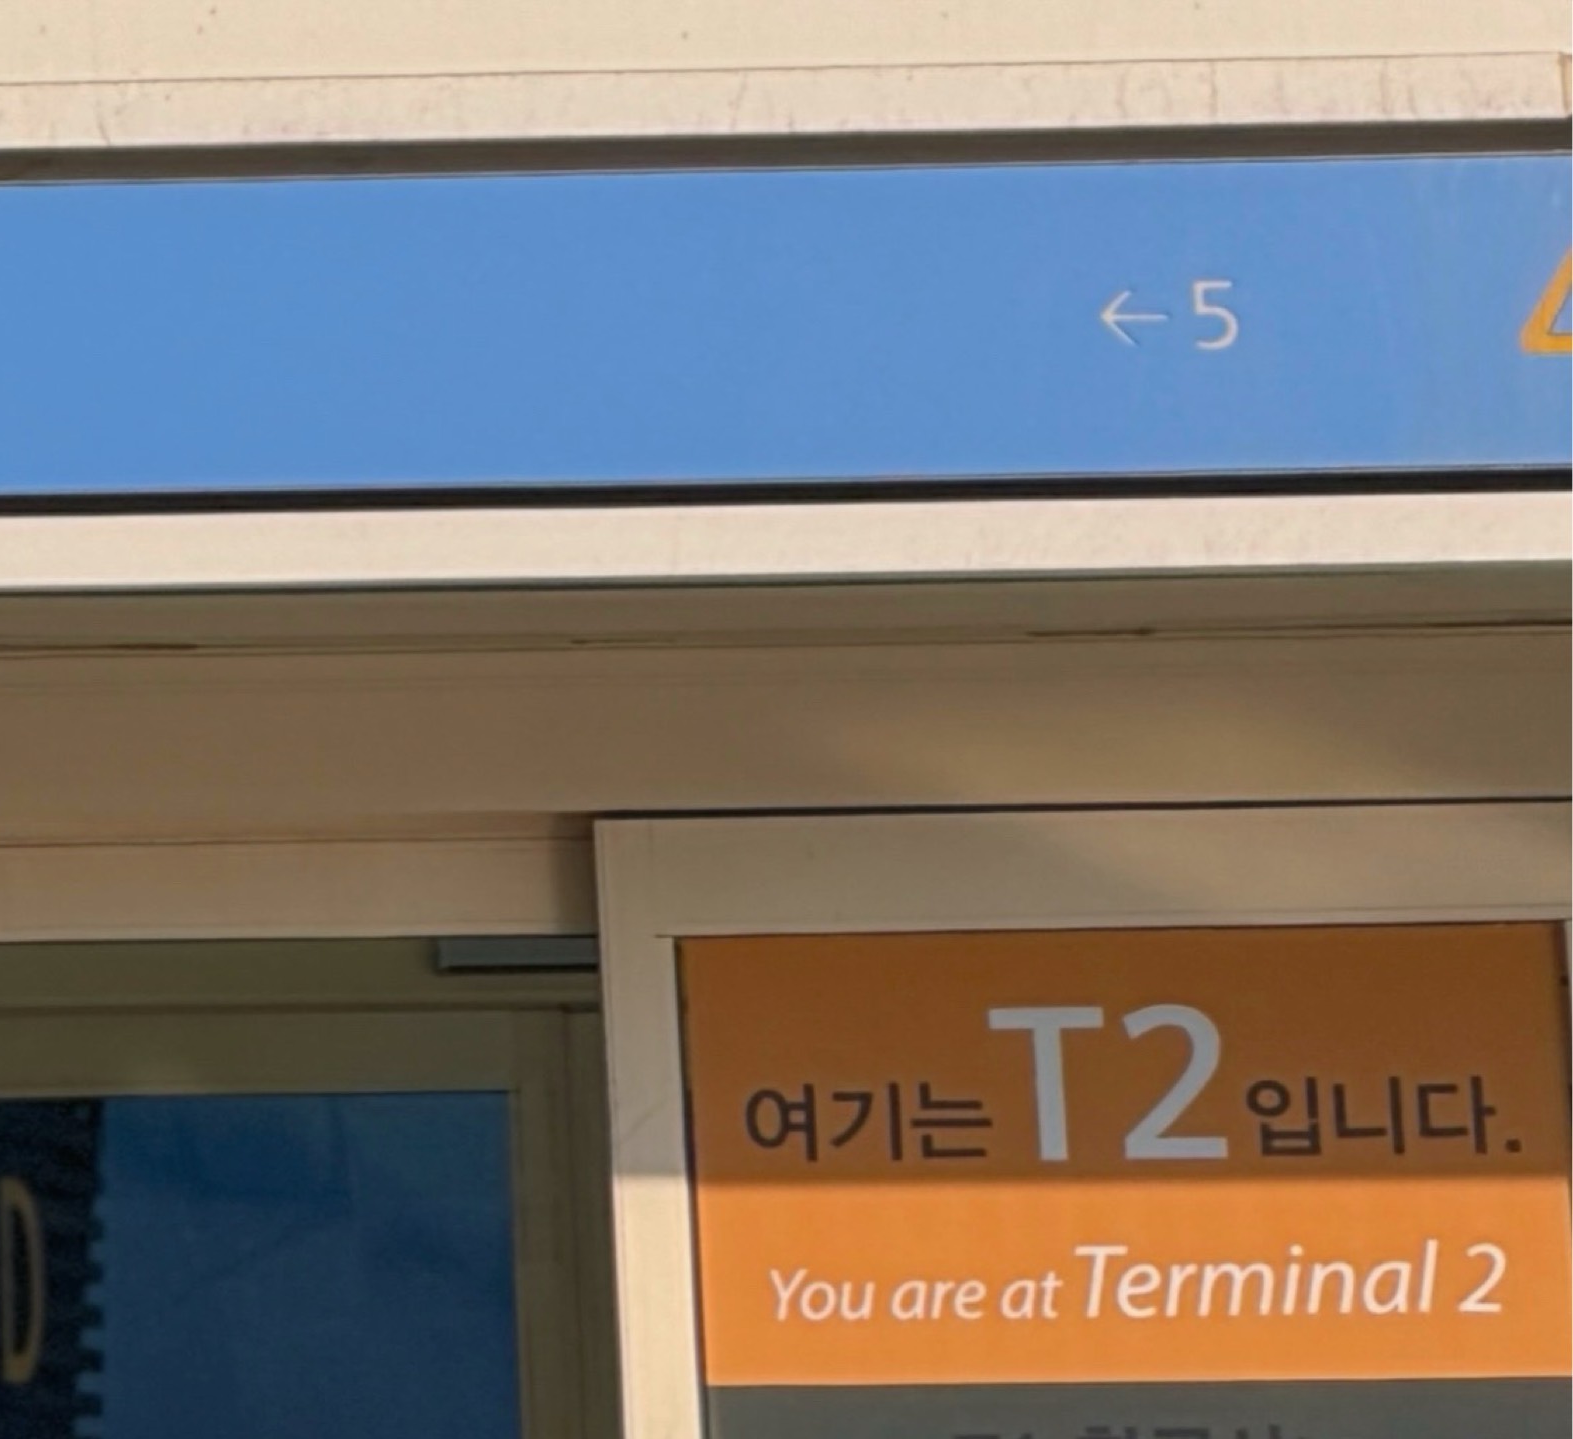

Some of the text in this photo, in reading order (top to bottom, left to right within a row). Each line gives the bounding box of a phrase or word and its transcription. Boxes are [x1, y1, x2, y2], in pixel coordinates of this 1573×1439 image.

[1193, 280, 1239, 350] 5
[745, 1004, 1524, 1162] 여기는 T2 입니다.
[771, 1239, 1508, 1321] You are at Terminal 2
